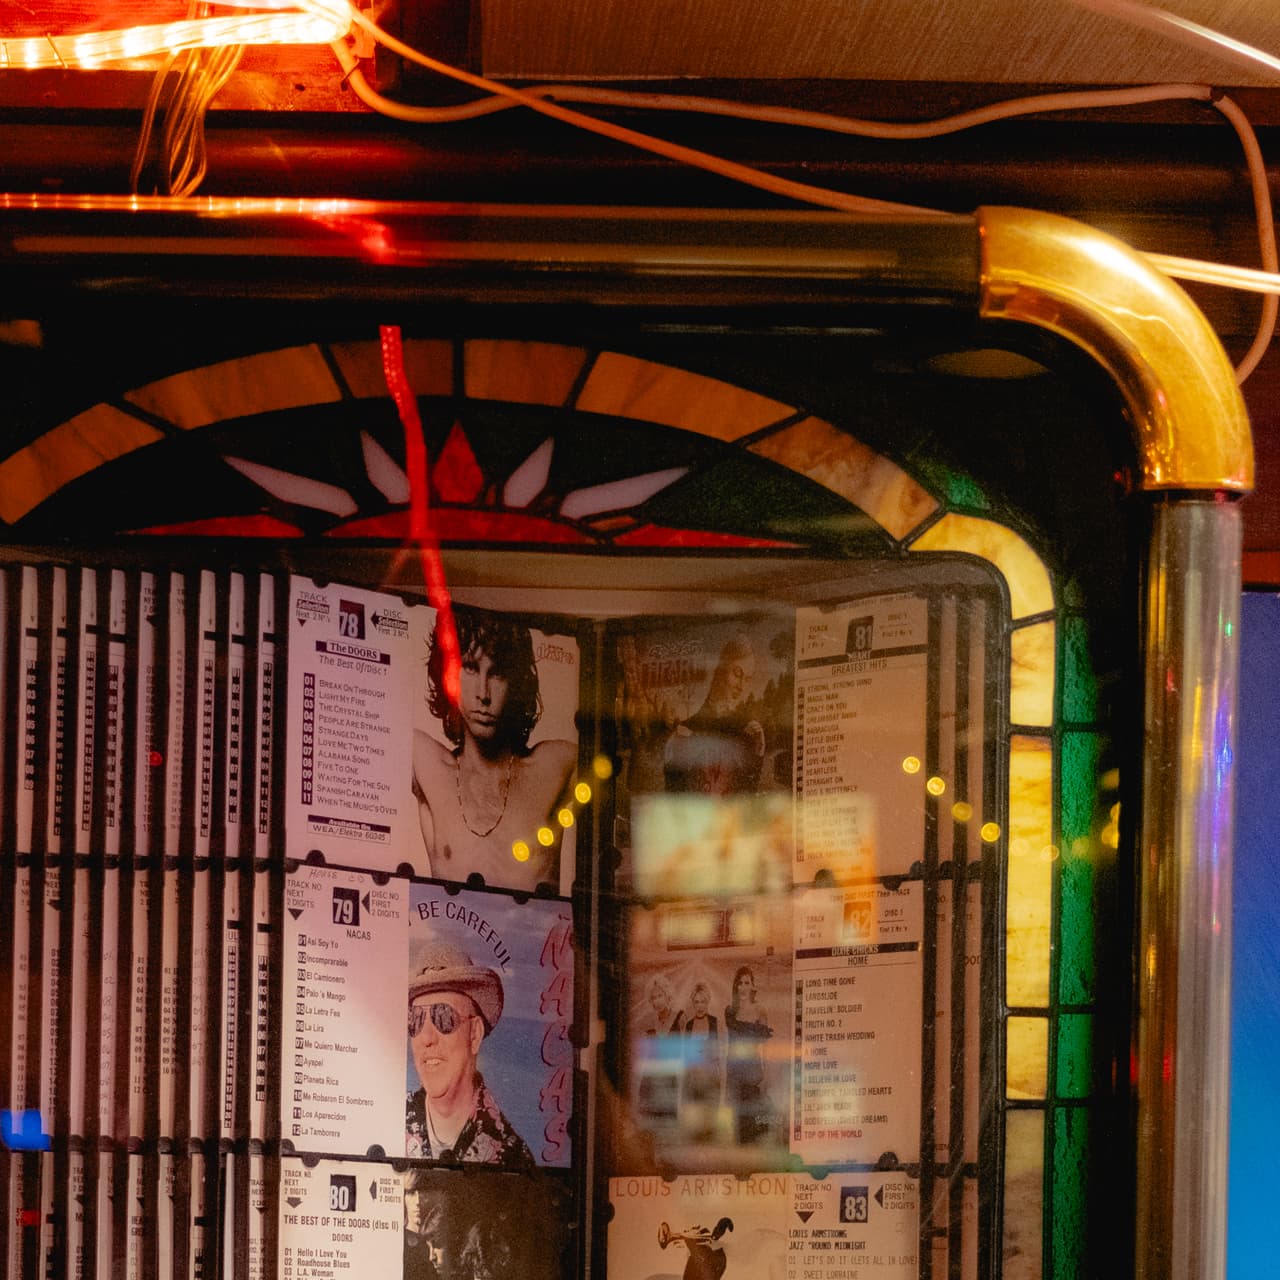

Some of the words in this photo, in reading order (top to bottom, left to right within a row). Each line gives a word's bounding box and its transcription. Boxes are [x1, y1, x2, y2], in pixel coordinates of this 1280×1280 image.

[300, 591, 327, 602] TRACK
[383, 609, 402, 619] DISC
[339, 611, 359, 637] 78
[855, 625, 872, 650] 81
[330, 642, 347, 652] The
[348, 646, 378, 659] DOORS
[832, 662, 867, 675] GREATEST
[869, 658, 888, 670] HITS
[287, 879, 310, 888] TRACK
[312, 883, 323, 891] NO
[287, 889, 305, 897] NEXT
[371, 890, 388, 899] DISC
[389, 892, 400, 901] NO
[292, 899, 316, 909] DIGITS
[371, 900, 392, 908] FIRST
[333, 898, 353, 924] 79
[371, 909, 375, 917] 2
[376, 909, 401, 919] DIGITS
[346, 929, 372, 941] NACAS
[417, 900, 441, 921] BE
[445, 900, 512, 974] CAREFUL
[318, 938, 329, 949] Soy
[330, 941, 339, 949] Yo
[847, 955, 869, 966] HOME
[302, 1110, 313, 1118] Los
[314, 1111, 346, 1121] Aparecidos
[615, 1179, 671, 1198] LOUIS
[795, 1183, 819, 1191] TRACK
[821, 1183, 832, 1191] NO
[885, 1183, 901, 1191] DISC
[902, 1183, 916, 1191] NO
[330, 1185, 349, 1210] 80
[885, 1192, 906, 1200] FIRST
[793, 1202, 798, 1210] 2
[799, 1202, 824, 1210] DIGITS
[845, 1196, 867, 1221] 83
[885, 1202, 889, 1210] 2
[890, 1202, 916, 1210] DIGITS
[284, 1214, 298, 1225] THE
[300, 1215, 319, 1226] BEST
[321, 1217, 331, 1226] OF
[333, 1217, 346, 1228] THE
[348, 1218, 370, 1229] DOORS
[332, 1232, 353, 1243] DOORS
[789, 1229, 808, 1239] LOUIS
[811, 1229, 848, 1239] ARMSTRONG
[788, 1241, 804, 1250] JAZZ
[834, 1241, 866, 1251] MIDNIGHT
[297, 1248, 314, 1257] Hello
[319, 1249, 334, 1258] Love
[336, 1249, 347, 1259] You
[297, 1258, 331, 1268] Roadhouse
[333, 1259, 351, 1268] Blues
[296, 1268, 309, 1276] L.A.
[311, 1268, 334, 1277] Woman
